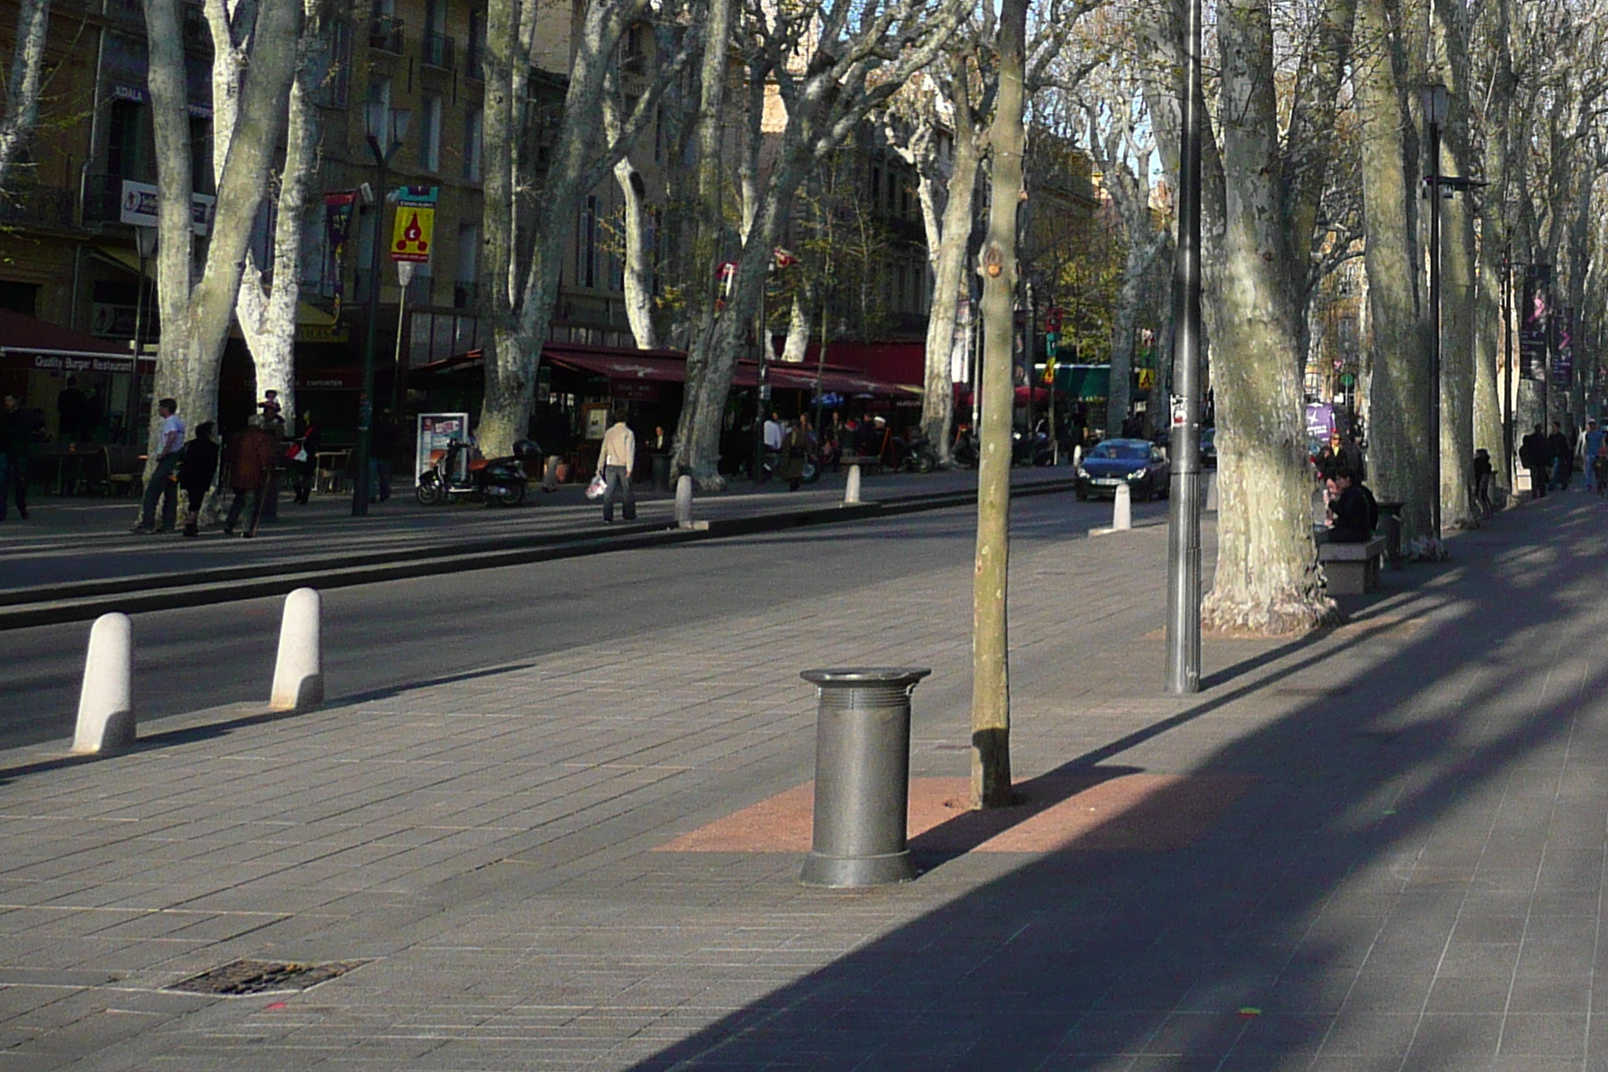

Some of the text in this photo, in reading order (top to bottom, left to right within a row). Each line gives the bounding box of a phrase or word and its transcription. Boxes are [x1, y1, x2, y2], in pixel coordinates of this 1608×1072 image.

[35, 355, 133, 371] Quality Burger Restaurant
